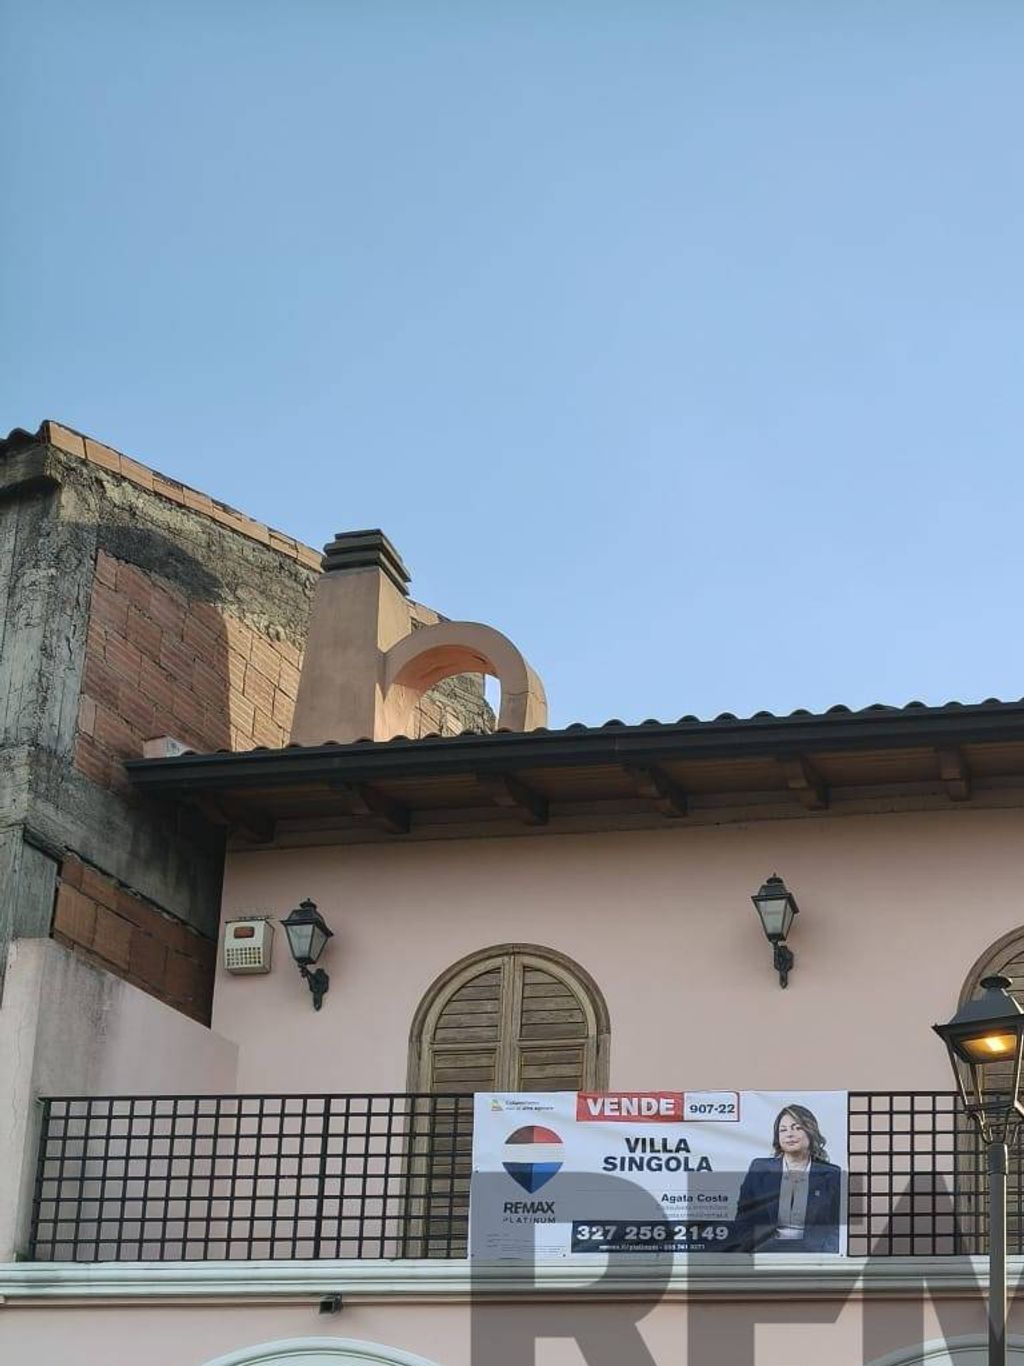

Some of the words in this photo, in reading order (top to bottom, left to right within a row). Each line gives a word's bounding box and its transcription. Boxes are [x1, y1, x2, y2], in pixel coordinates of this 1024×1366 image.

[587, 1097, 675, 1116] VENDE
[689, 1103, 735, 1114] 907-22
[625, 1137, 691, 1153] VILLA
[602, 1156, 713, 1172] SINGOLA
[661, 1193, 694, 1204] Agata
[697, 1193, 729, 1203] Costa
[503, 1201, 556, 1214] REMAX
[576, 1225, 617, 1240] 327
[624, 1225, 666, 1240] 256
[673, 1225, 729, 1240] 2149
